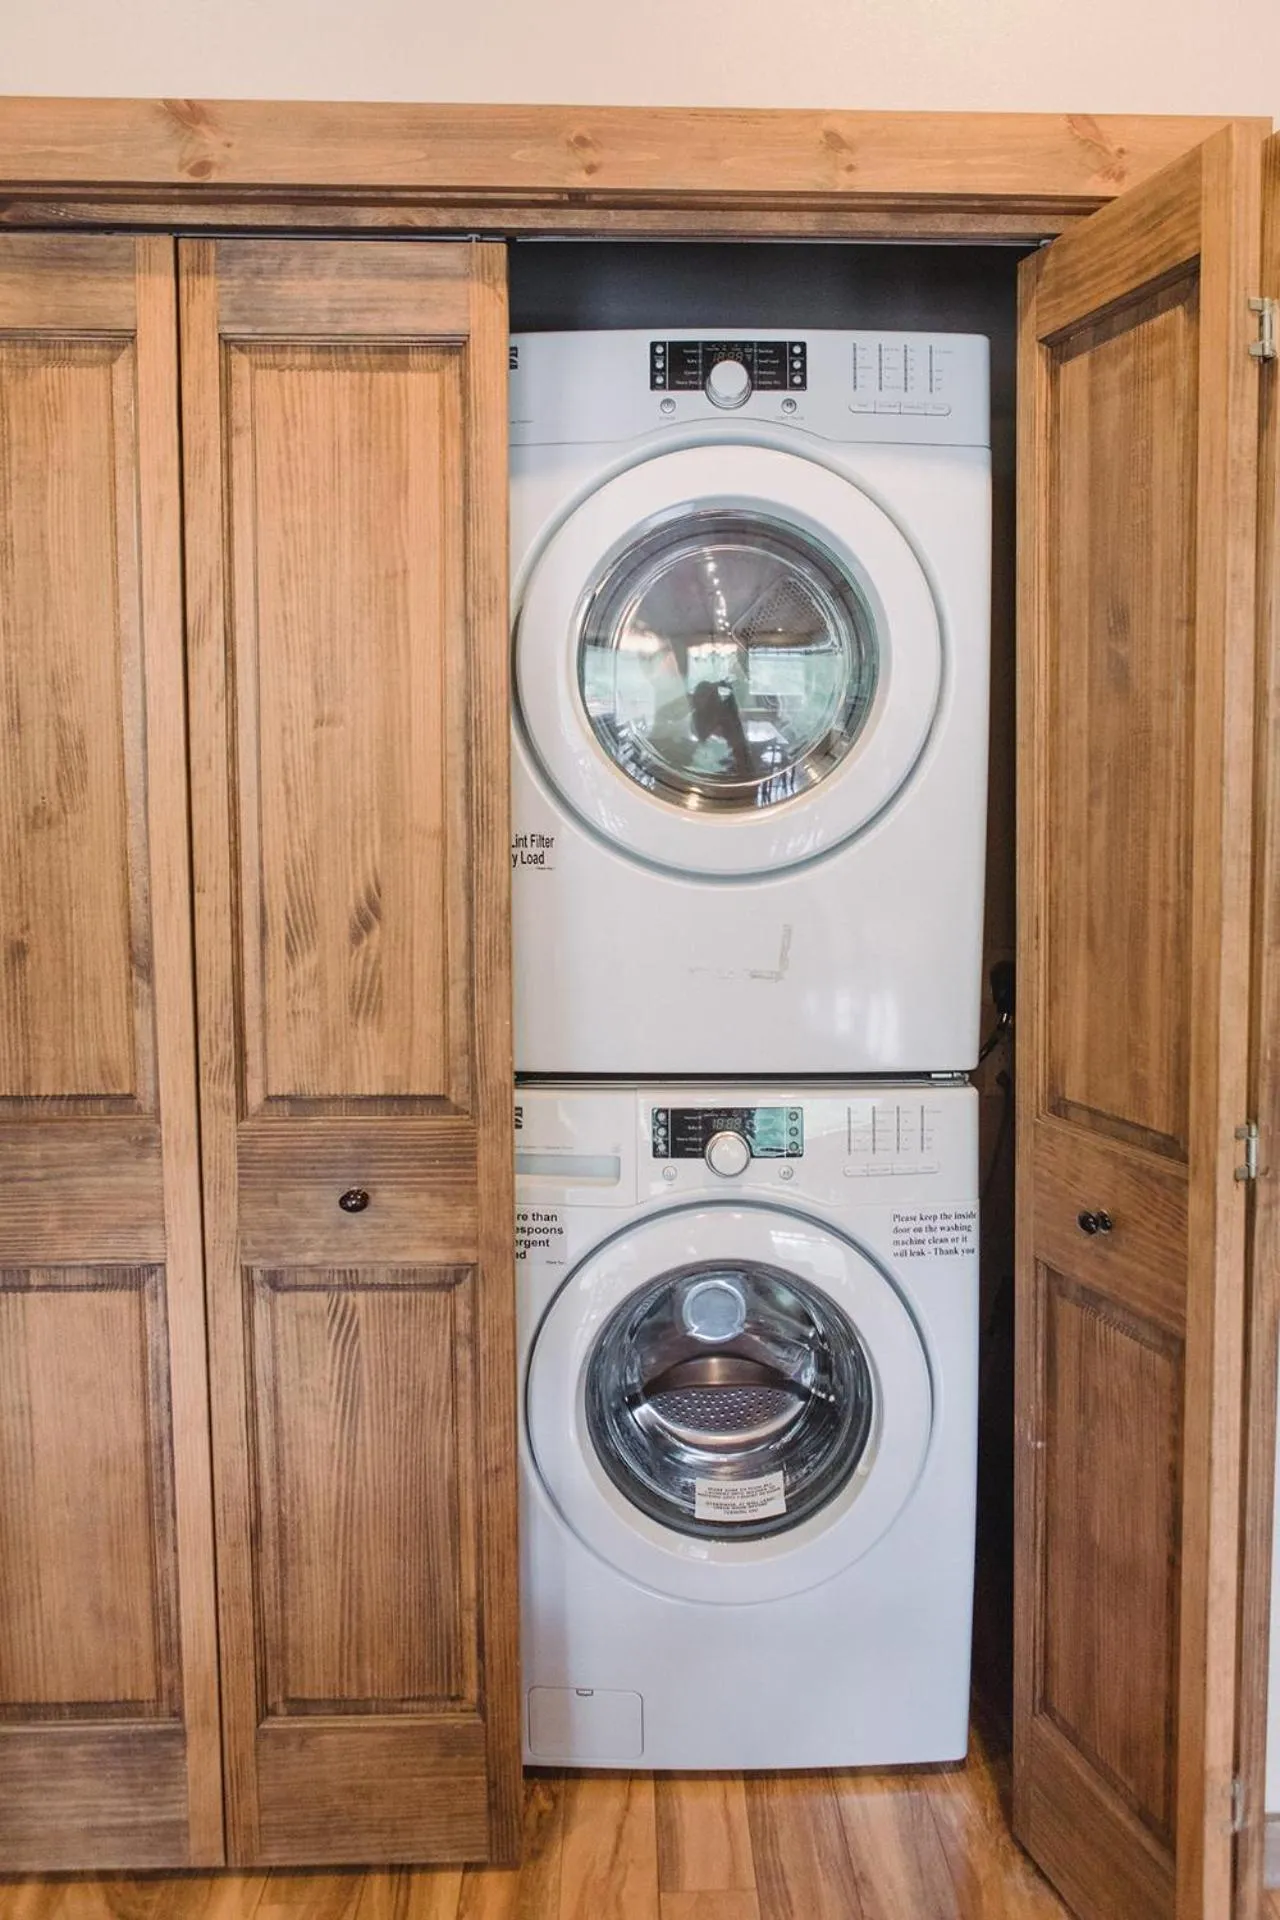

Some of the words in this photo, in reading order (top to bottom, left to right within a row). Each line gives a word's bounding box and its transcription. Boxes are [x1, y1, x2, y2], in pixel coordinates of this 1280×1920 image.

[530, 834, 555, 848] Filter
[521, 851, 545, 865] Load
[531, 1212, 558, 1221] than
[893, 1213, 917, 1223] Please
[919, 1212, 938, 1223] keep
[940, 1212, 952, 1221] the
[954, 1210, 977, 1221] inside
[893, 1225, 911, 1234] door
[925, 1224, 937, 1233] the
[939, 1223, 972, 1234] washing
[892, 1237, 926, 1247] machine
[928, 1235, 949, 1245] clean
[961, 1235, 968, 1243] it
[893, 1249, 907, 1258] will
[909, 1248, 926, 1257] leak
[934, 1247, 959, 1256] Thank
[961, 1248, 975, 1257] you
